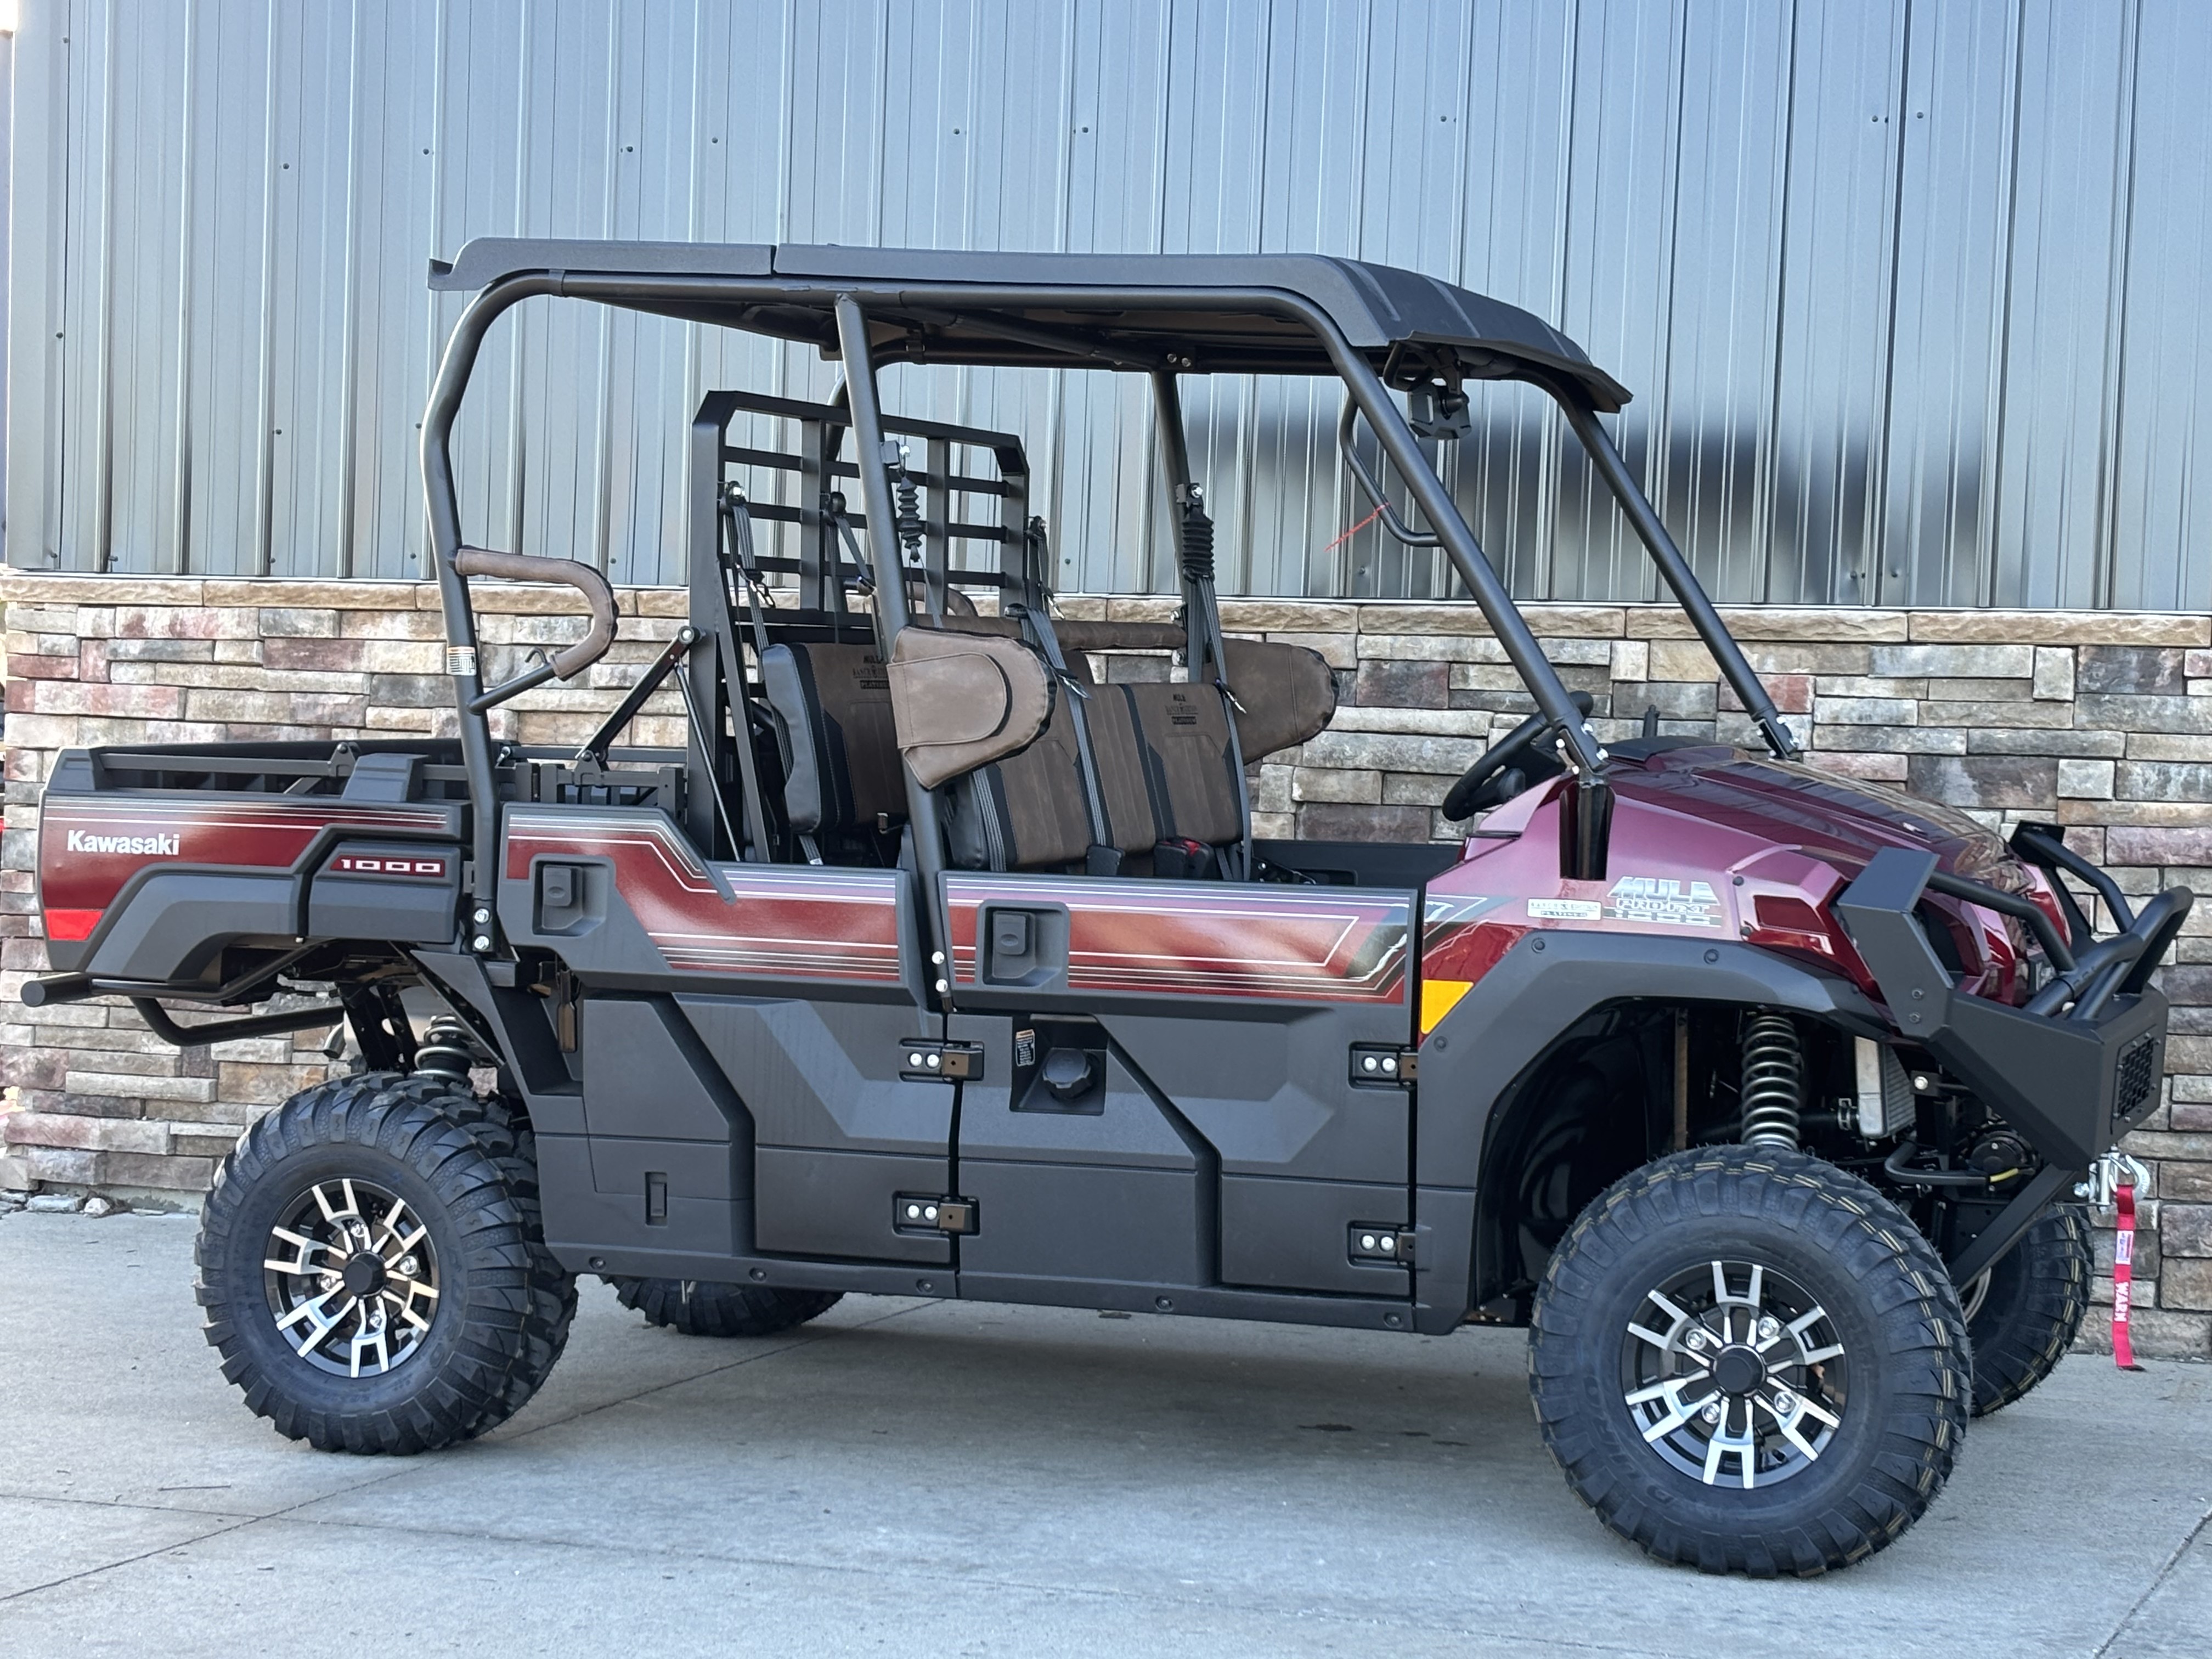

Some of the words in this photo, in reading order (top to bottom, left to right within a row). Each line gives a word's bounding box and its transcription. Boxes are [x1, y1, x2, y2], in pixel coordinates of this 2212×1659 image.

[67, 830, 180, 855] Kawasaki
[341, 859, 441, 873] 1000
[1607, 876, 1721, 906] MULE
[2114, 1281, 2129, 1322] WARN
